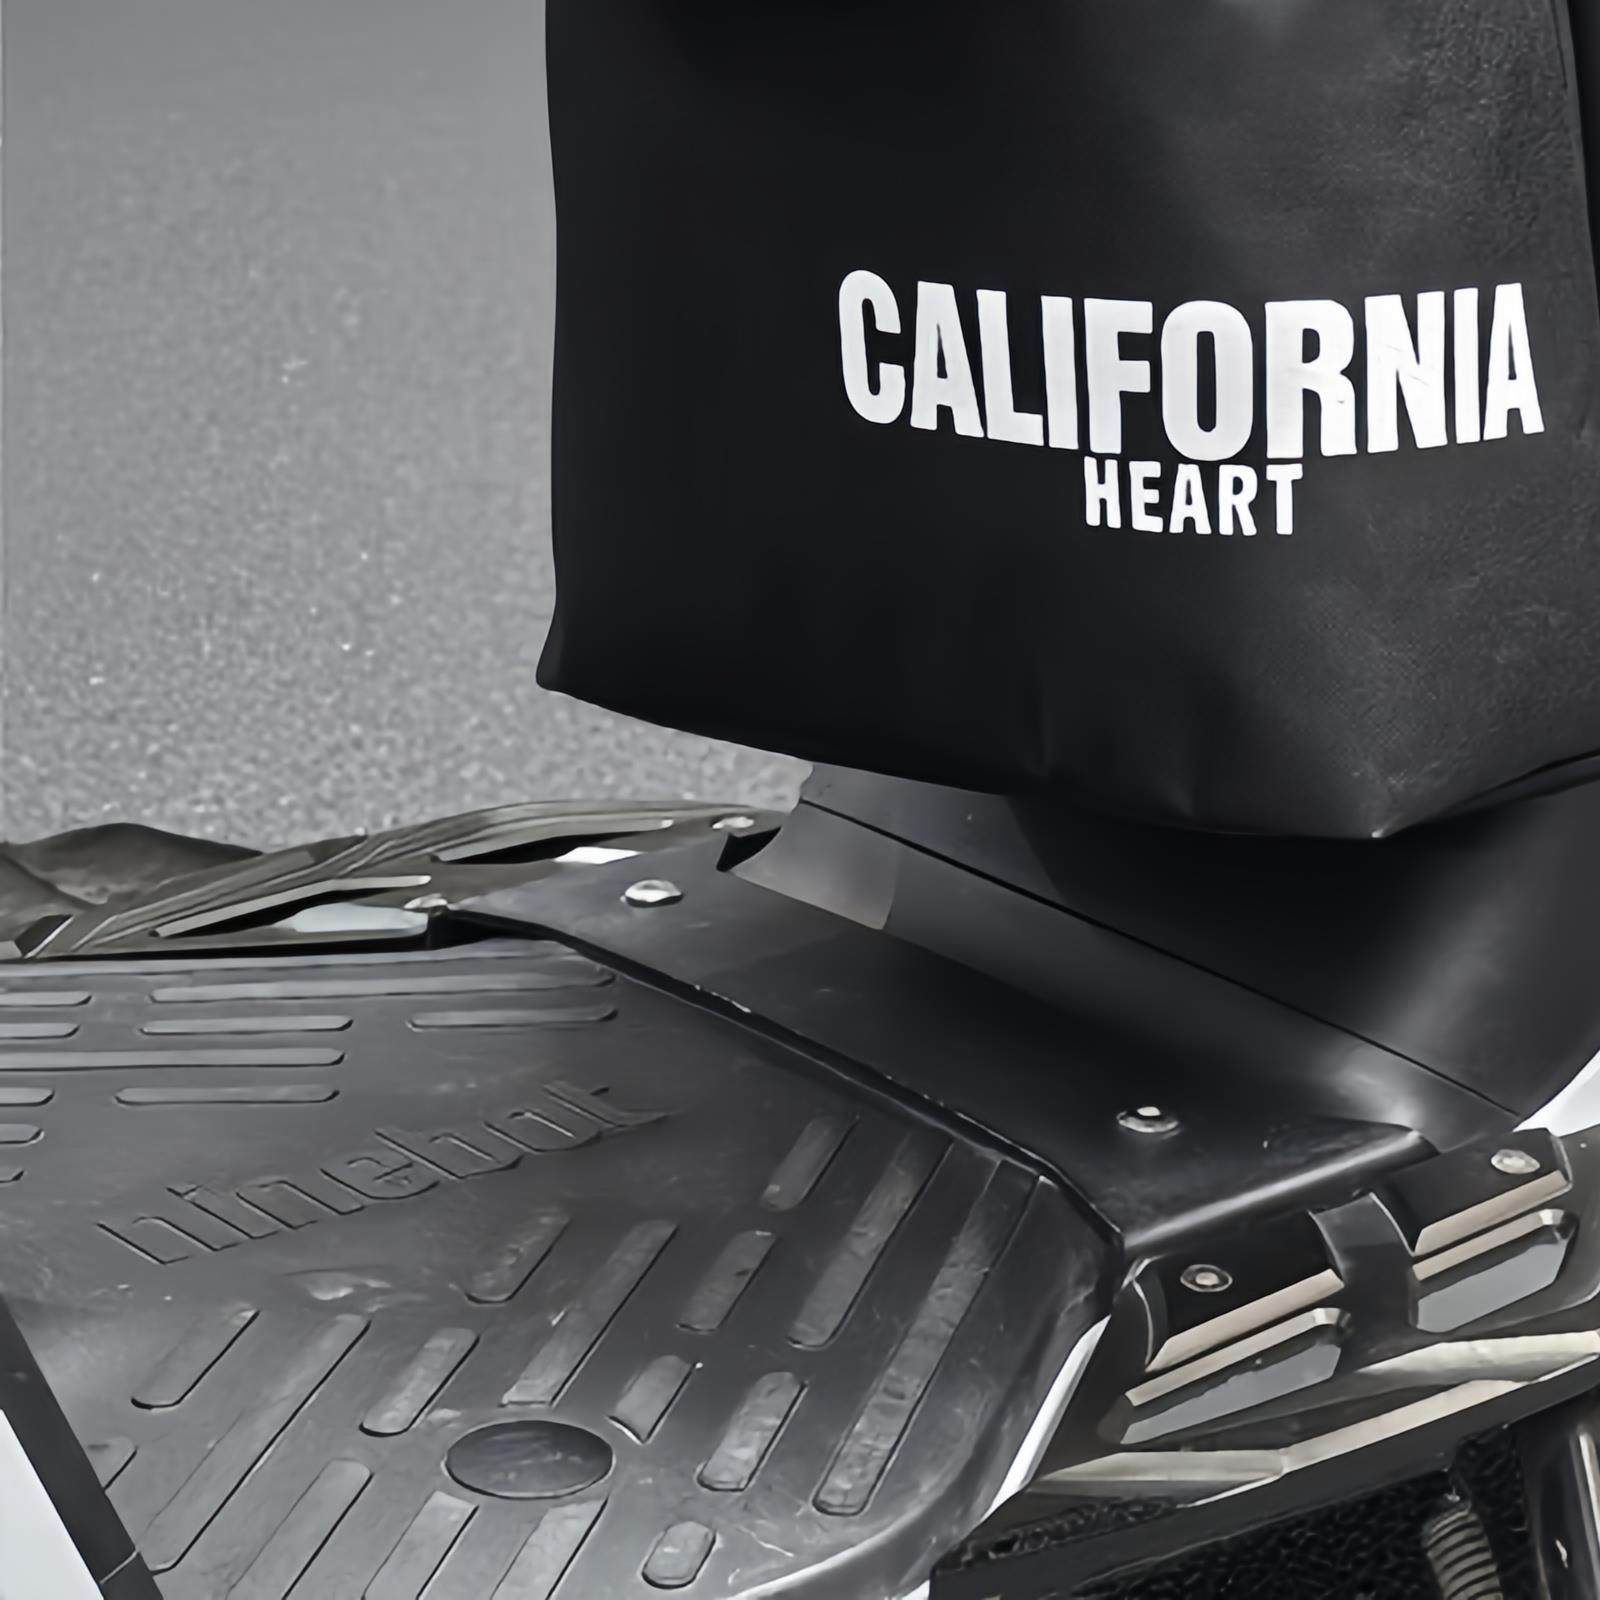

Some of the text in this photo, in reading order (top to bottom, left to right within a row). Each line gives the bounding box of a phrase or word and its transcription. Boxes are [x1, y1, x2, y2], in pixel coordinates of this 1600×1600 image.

[838, 269, 1546, 462] CALIFORNIA
[1083, 455, 1303, 537] HEART
[95, 1080, 672, 1265] ninebot
